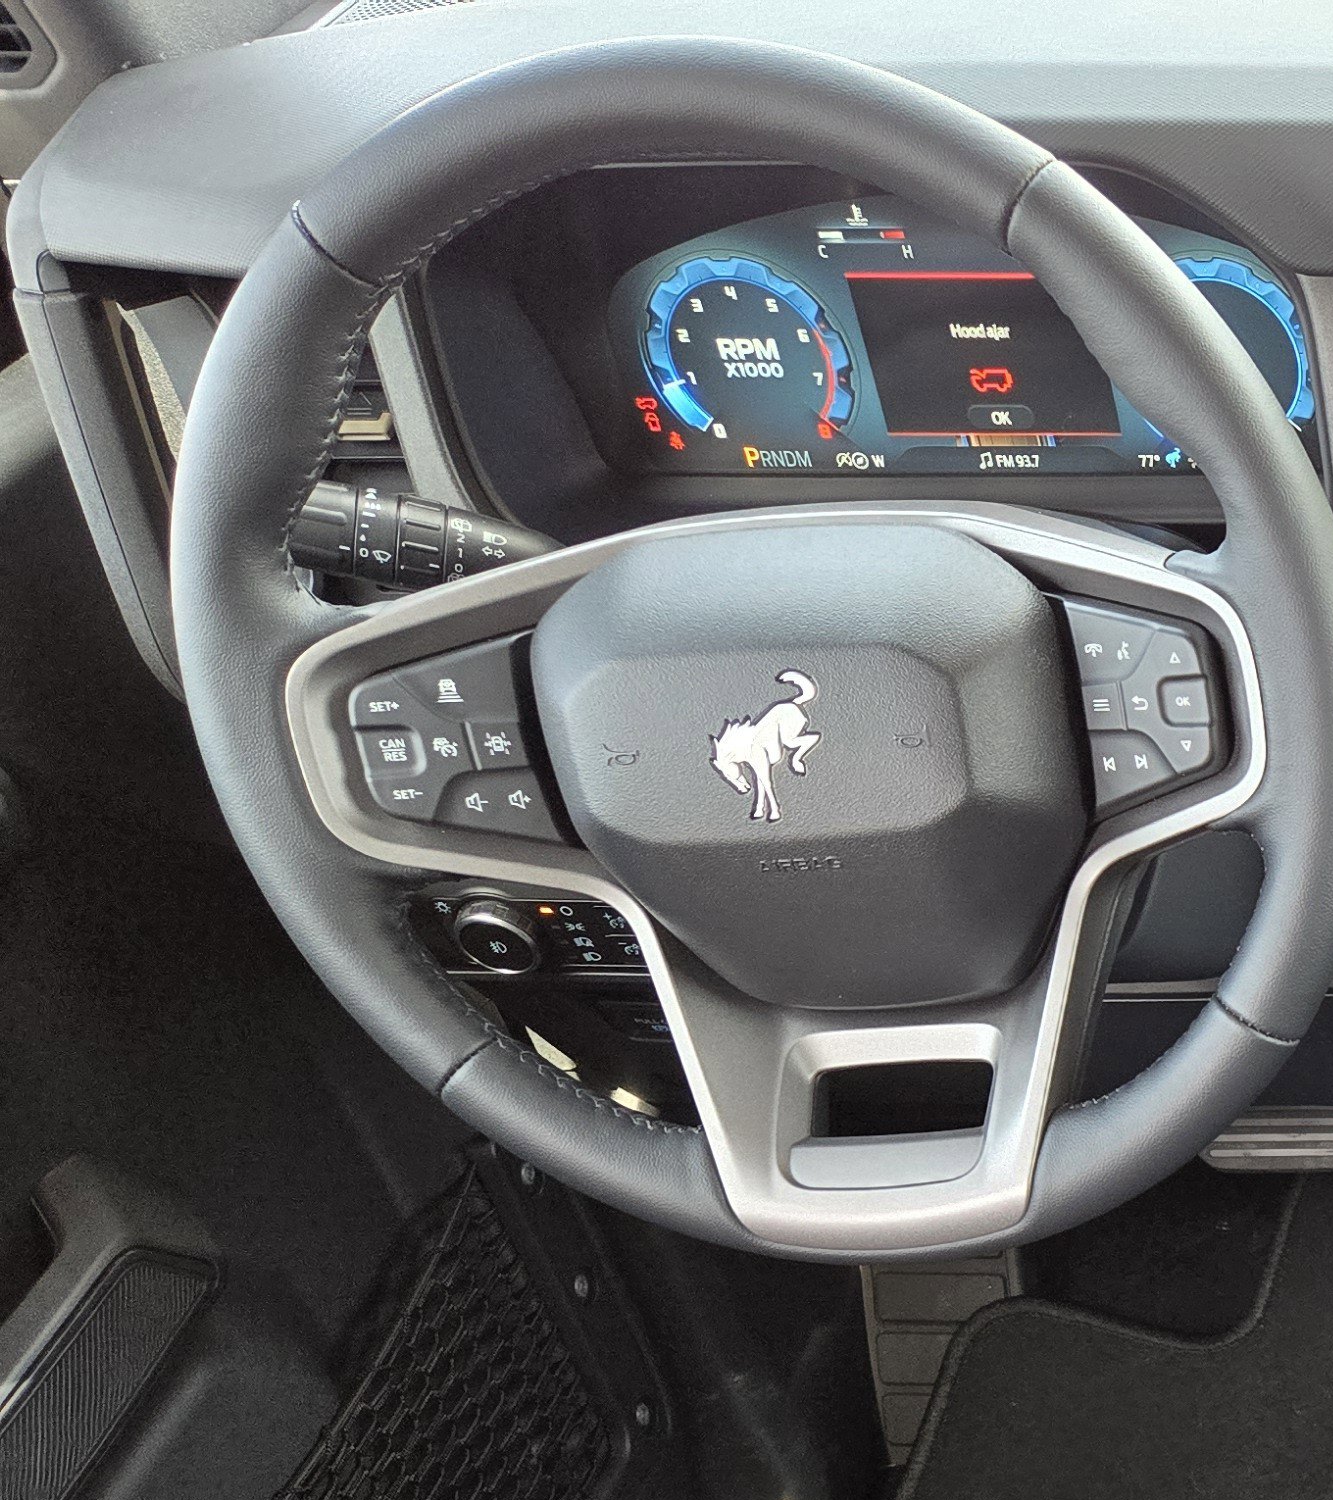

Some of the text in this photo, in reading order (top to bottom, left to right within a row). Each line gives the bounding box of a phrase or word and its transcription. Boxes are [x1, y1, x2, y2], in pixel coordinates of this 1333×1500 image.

[817, 245, 914, 259] C H
[724, 286, 737, 300] 4
[690, 298, 703, 312] 3
[765, 298, 779, 312] 5
[676, 329, 690, 343] 2
[797, 329, 810, 343] 6
[949, 323, 986, 338] Hood
[716, 338, 781, 361] RPM
[725, 363, 784, 378] X1000
[686, 372, 697, 384] 1
[813, 373, 824, 385] 7
[990, 411, 1012, 426] OK
[713, 424, 727, 438] 0
[818, 423, 832, 439] 8
[871, 455, 885, 467] W
[995, 455, 1039, 468] FM 93.7
[456, 533, 466, 543] 2
[1175, 696, 1191, 707] OK
[379, 738, 406, 749] CAN
[383, 752, 408, 762] RES
